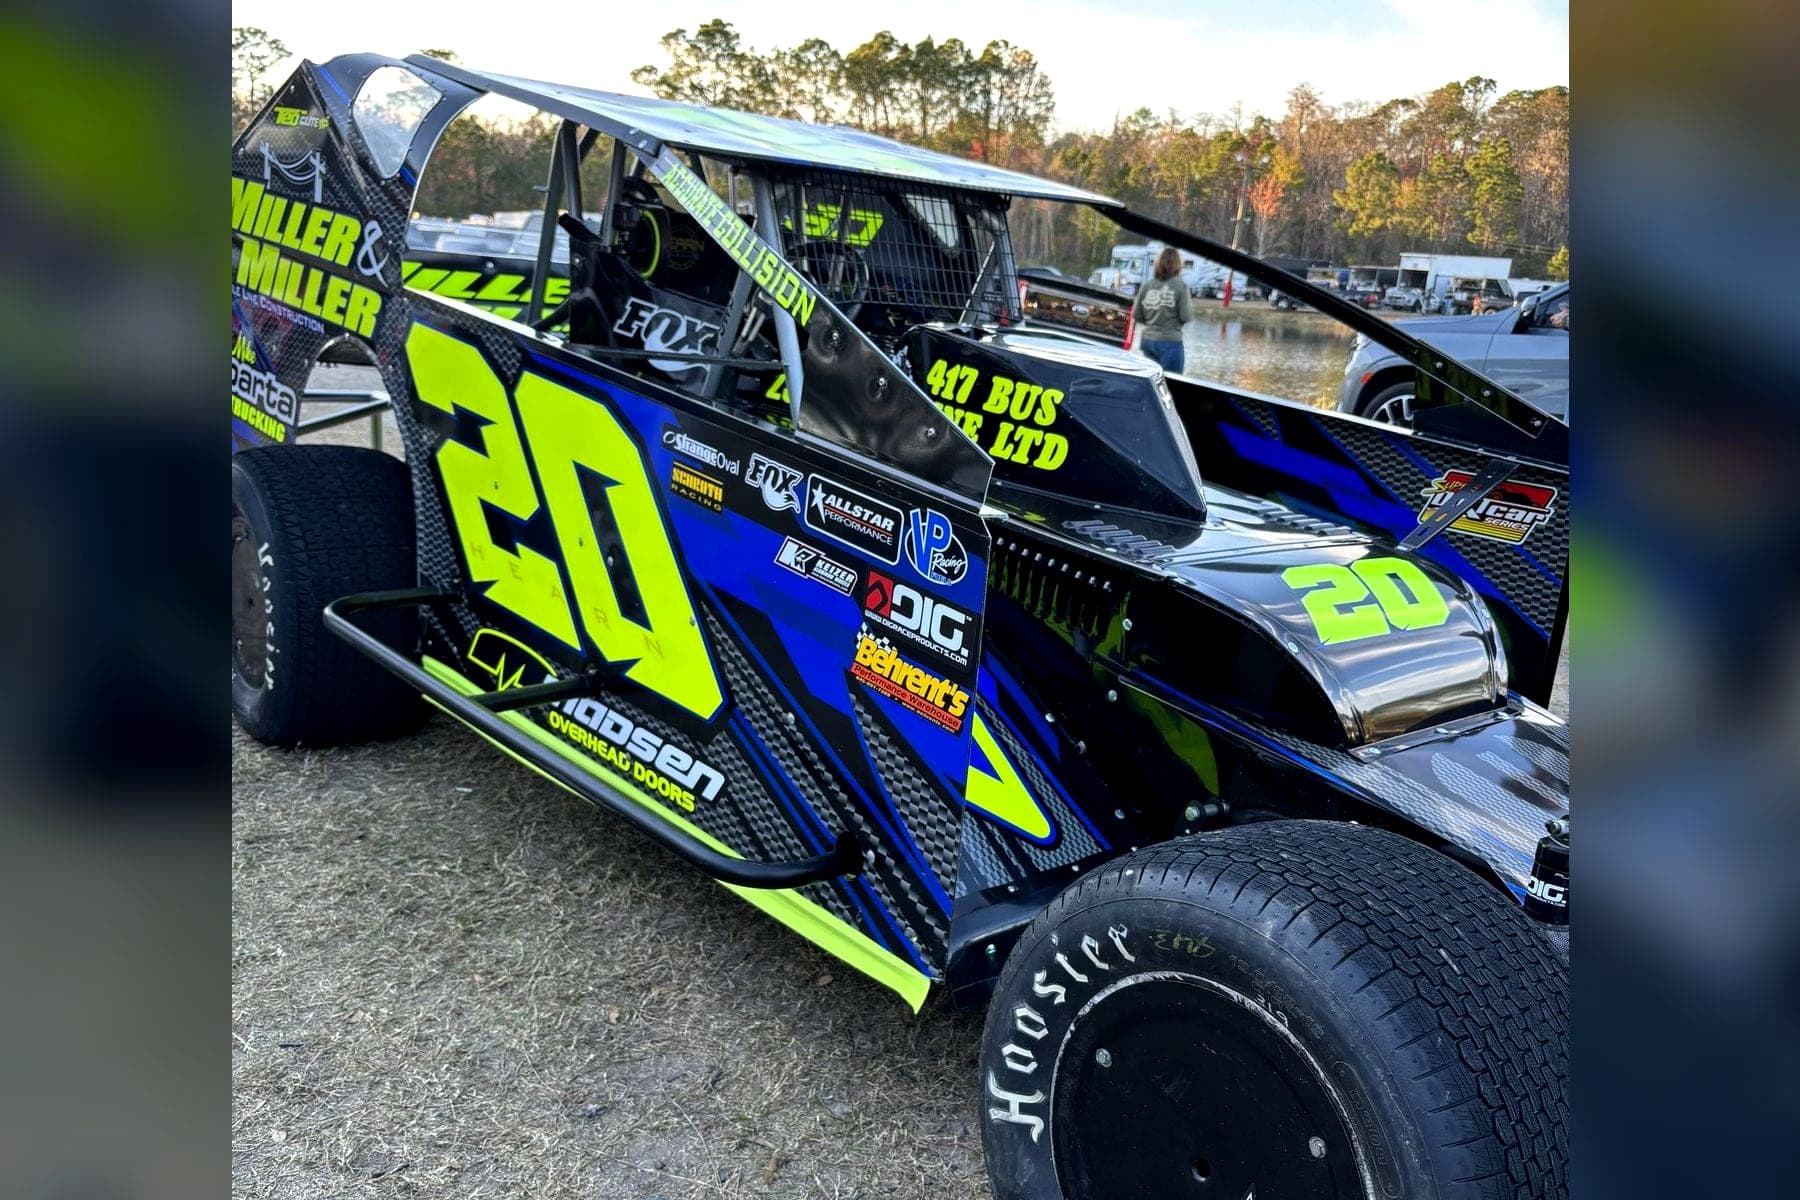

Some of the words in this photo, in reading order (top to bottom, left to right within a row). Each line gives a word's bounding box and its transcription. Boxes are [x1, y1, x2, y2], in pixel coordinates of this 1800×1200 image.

[232, 177, 362, 266] MILLER
[356, 220, 389, 288] &
[235, 237, 383, 339] MILLER
[713, 211, 817, 328] COLLISION
[260, 296, 325, 334] CONSTRUCTION
[613, 297, 720, 357] FOX
[926, 359, 979, 404] 417
[982, 376, 1064, 426] BUS
[989, 422, 1069, 471] LTD
[671, 483, 722, 511] RACING
[745, 453, 803, 502] FOX
[405, 321, 724, 720] 20
[824, 494, 895, 532] ALLSTAR
[824, 510, 894, 546] PERFORMANCE
[814, 559, 856, 583] KEIZER
[910, 508, 953, 578] VP
[931, 552, 968, 575] Racing
[1280, 556, 1450, 646] 20
[854, 665, 907, 699] Performance
[855, 636, 969, 717] Behrent's
[909, 694, 959, 727] Warehouse
[549, 710, 631, 773] OVERHEAD
[633, 760, 696, 813] DOORS
[988, 923, 1136, 1144] Hoosier
